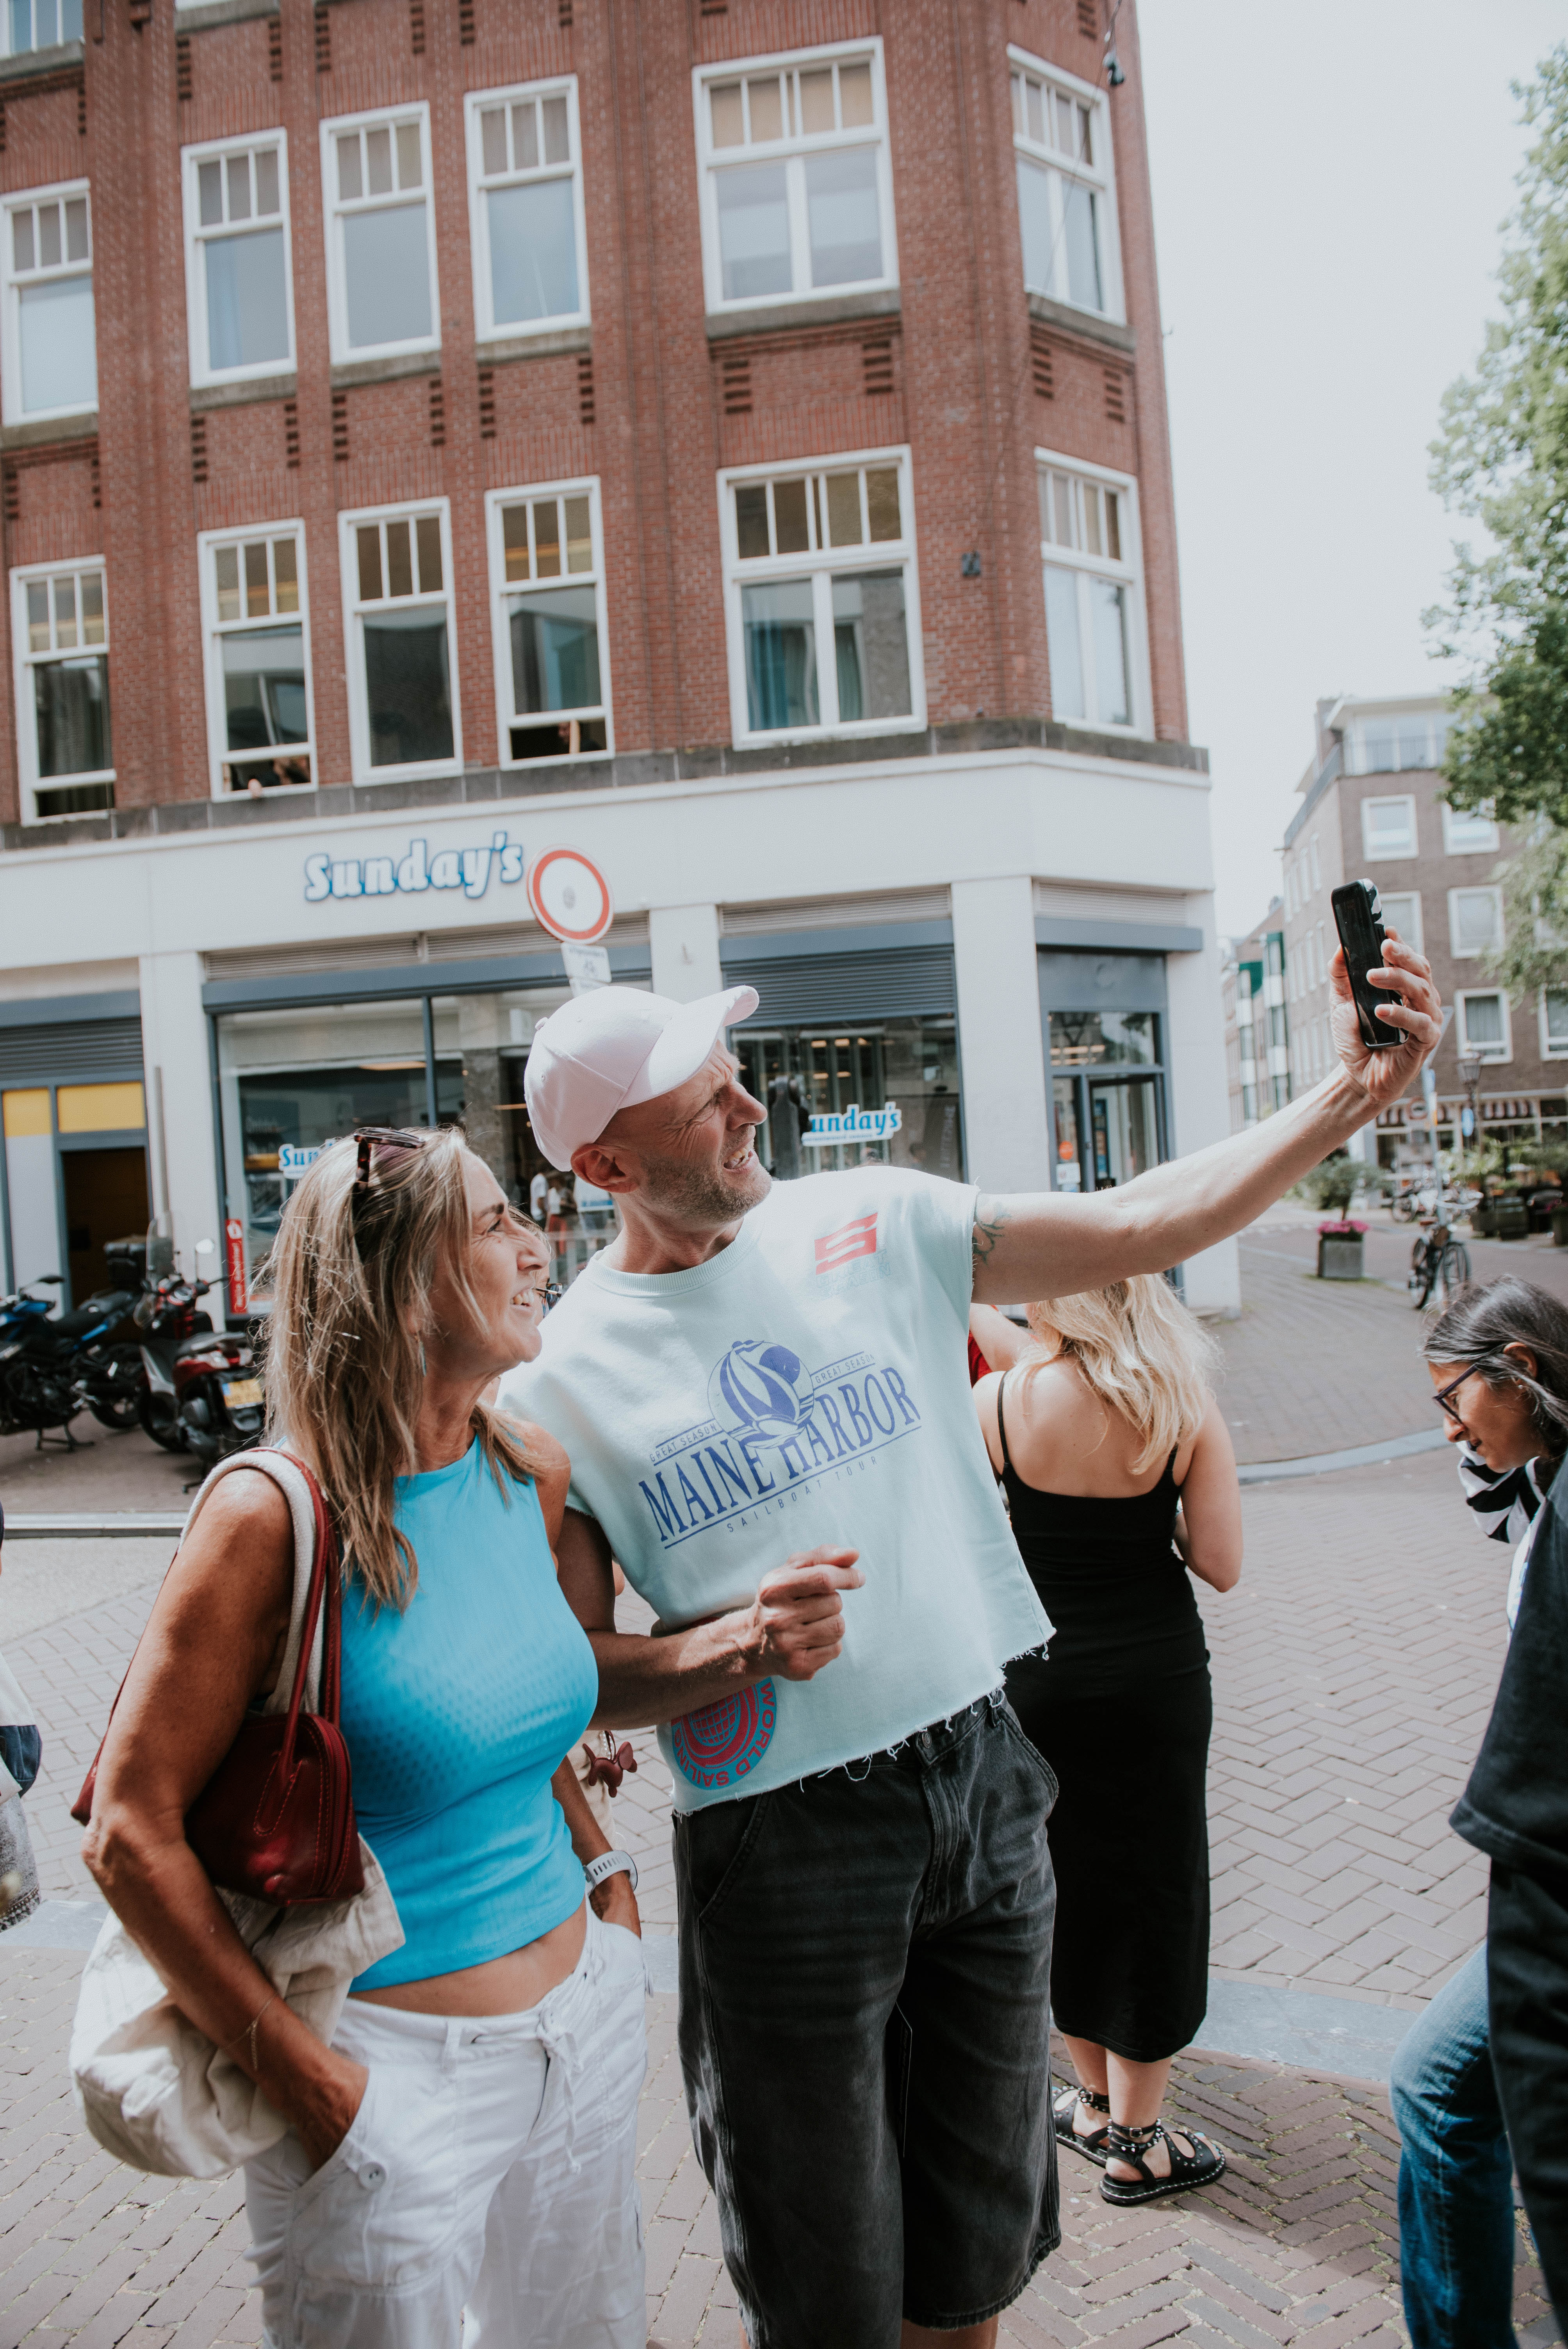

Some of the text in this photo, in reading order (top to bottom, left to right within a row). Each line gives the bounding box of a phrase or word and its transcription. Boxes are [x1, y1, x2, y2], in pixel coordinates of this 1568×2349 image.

[305, 831, 524, 902] Sunday's
[283, 1143, 333, 1166] Sun
[811, 1105, 898, 1135] unday's
[815, 1365, 841, 1384] GREAT
[649, 1423, 717, 1462] GREAT SEASON
[777, 1367, 921, 1479] HARBOR
[638, 1439, 776, 1542] MAINE
[727, 1456, 878, 1533] SAILBOAT TOUR
[735, 1681, 775, 1776] WORLD
